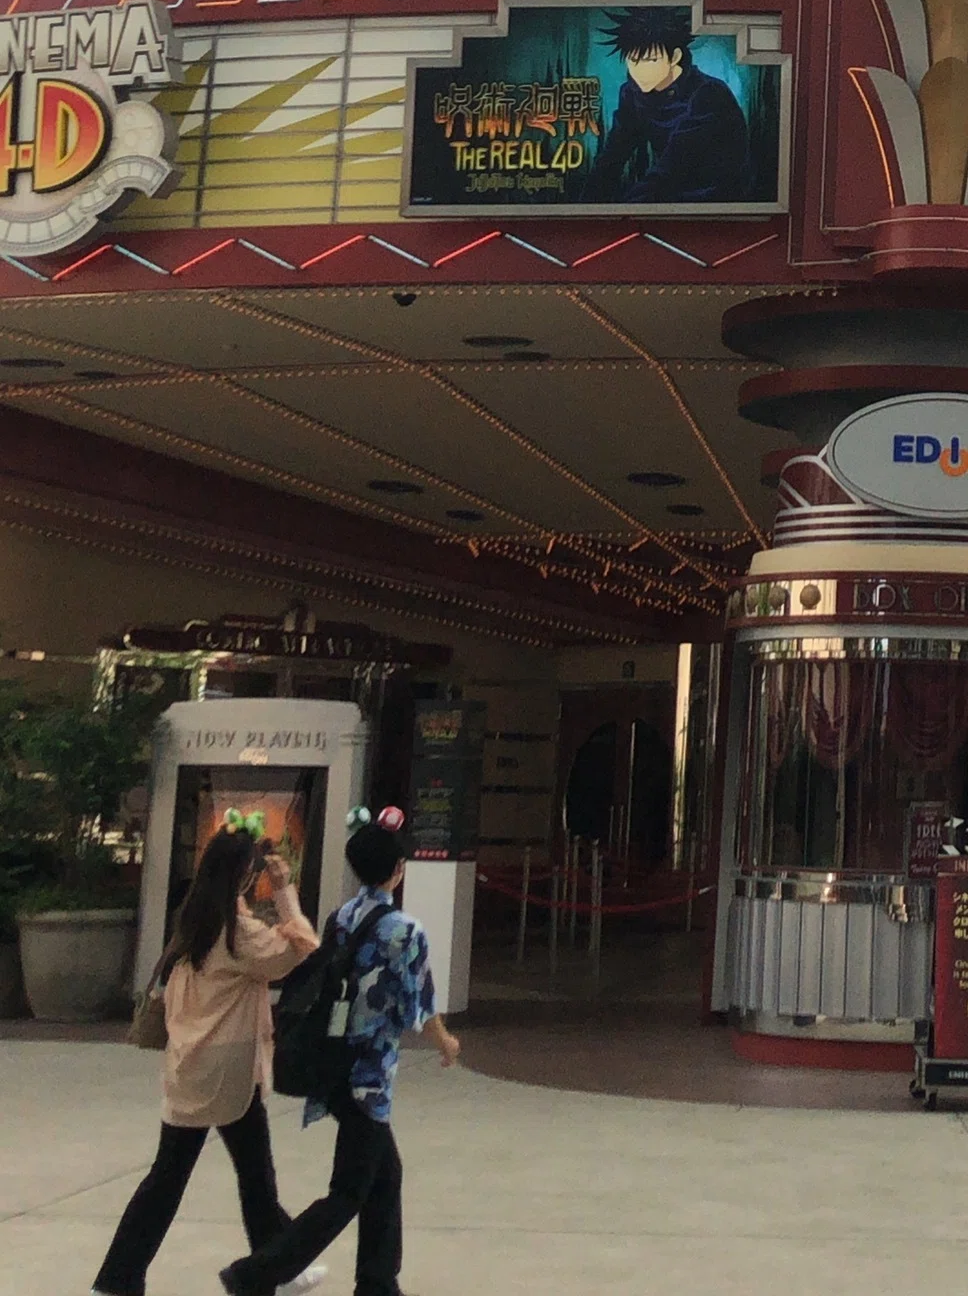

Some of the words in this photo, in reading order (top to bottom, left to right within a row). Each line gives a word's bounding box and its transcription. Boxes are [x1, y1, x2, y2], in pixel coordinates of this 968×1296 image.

[450, 141, 486, 171] THE
[490, 140, 548, 170] REAL
[551, 141, 583, 173] 4D
[852, 583, 911, 610] BOX
[186, 730, 237, 748] NOW
[245, 731, 327, 751] PLAYING
